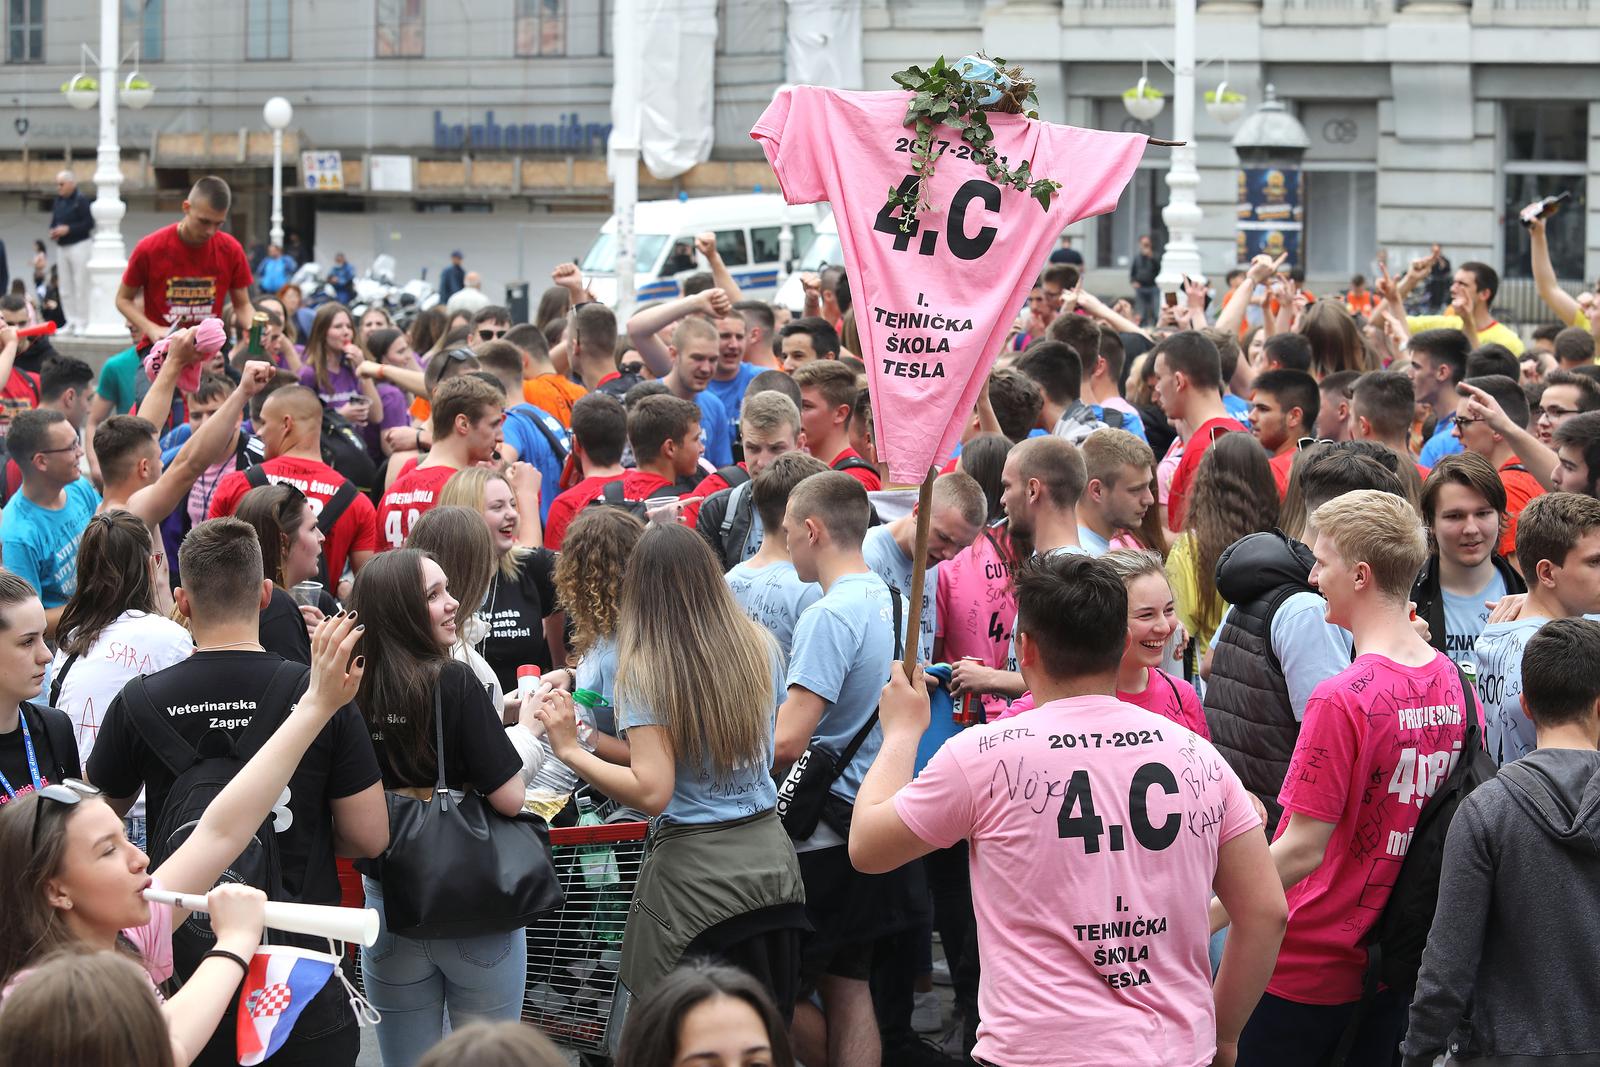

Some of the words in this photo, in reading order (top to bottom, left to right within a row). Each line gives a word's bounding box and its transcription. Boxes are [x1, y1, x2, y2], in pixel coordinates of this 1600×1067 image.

[873, 174, 1002, 260] 4.C
[917, 292, 929, 307] I.
[874, 307, 973, 331] TEHNIČKA
[886, 332, 950, 353] ŠKOLA
[883, 359, 945, 378] TESLA
[492, 619, 517, 629] zato
[493, 628, 531, 639] natpis!
[1446, 634, 1480, 651] ZNA
[106, 642, 152, 673] SARA
[167, 700, 256, 717] Veterinarska
[209, 717, 252, 730] Zagre
[1048, 729, 1165, 750] 2017-2021
[777, 754, 809, 818] didas
[1057, 762, 1182, 855] 4.C
[1116, 895, 1129, 912] I.
[1073, 915, 1167, 941] TEHNIČKA
[1094, 944, 1149, 967] ŠKOLA
